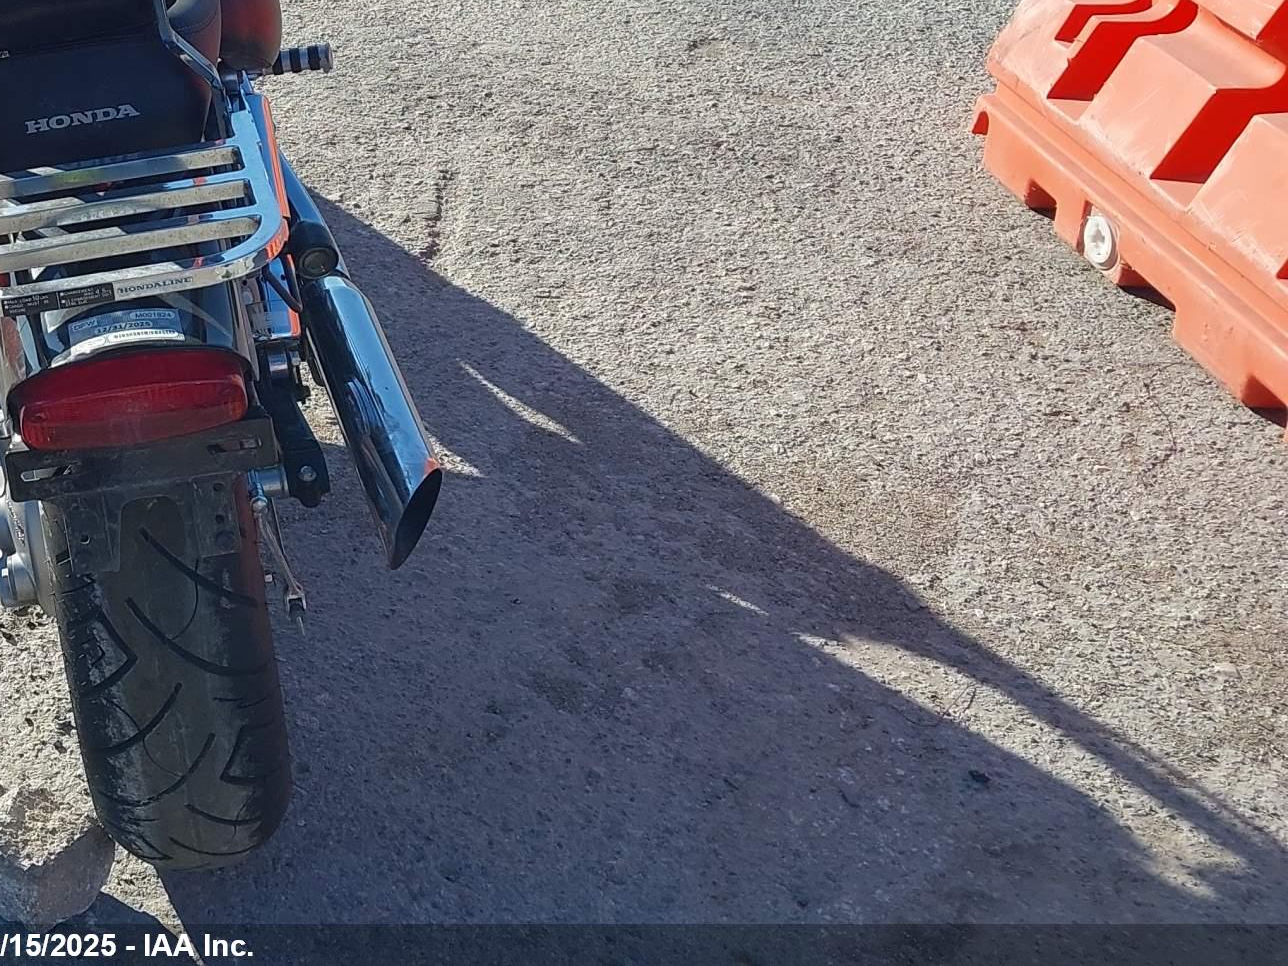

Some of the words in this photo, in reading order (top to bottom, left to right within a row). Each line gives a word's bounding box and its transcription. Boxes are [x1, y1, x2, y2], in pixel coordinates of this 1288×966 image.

[25, 104, 140, 134] HONDA
[117, 276, 194, 294] HONDALINE
[96, 321, 152, 334] 12/31/2025
